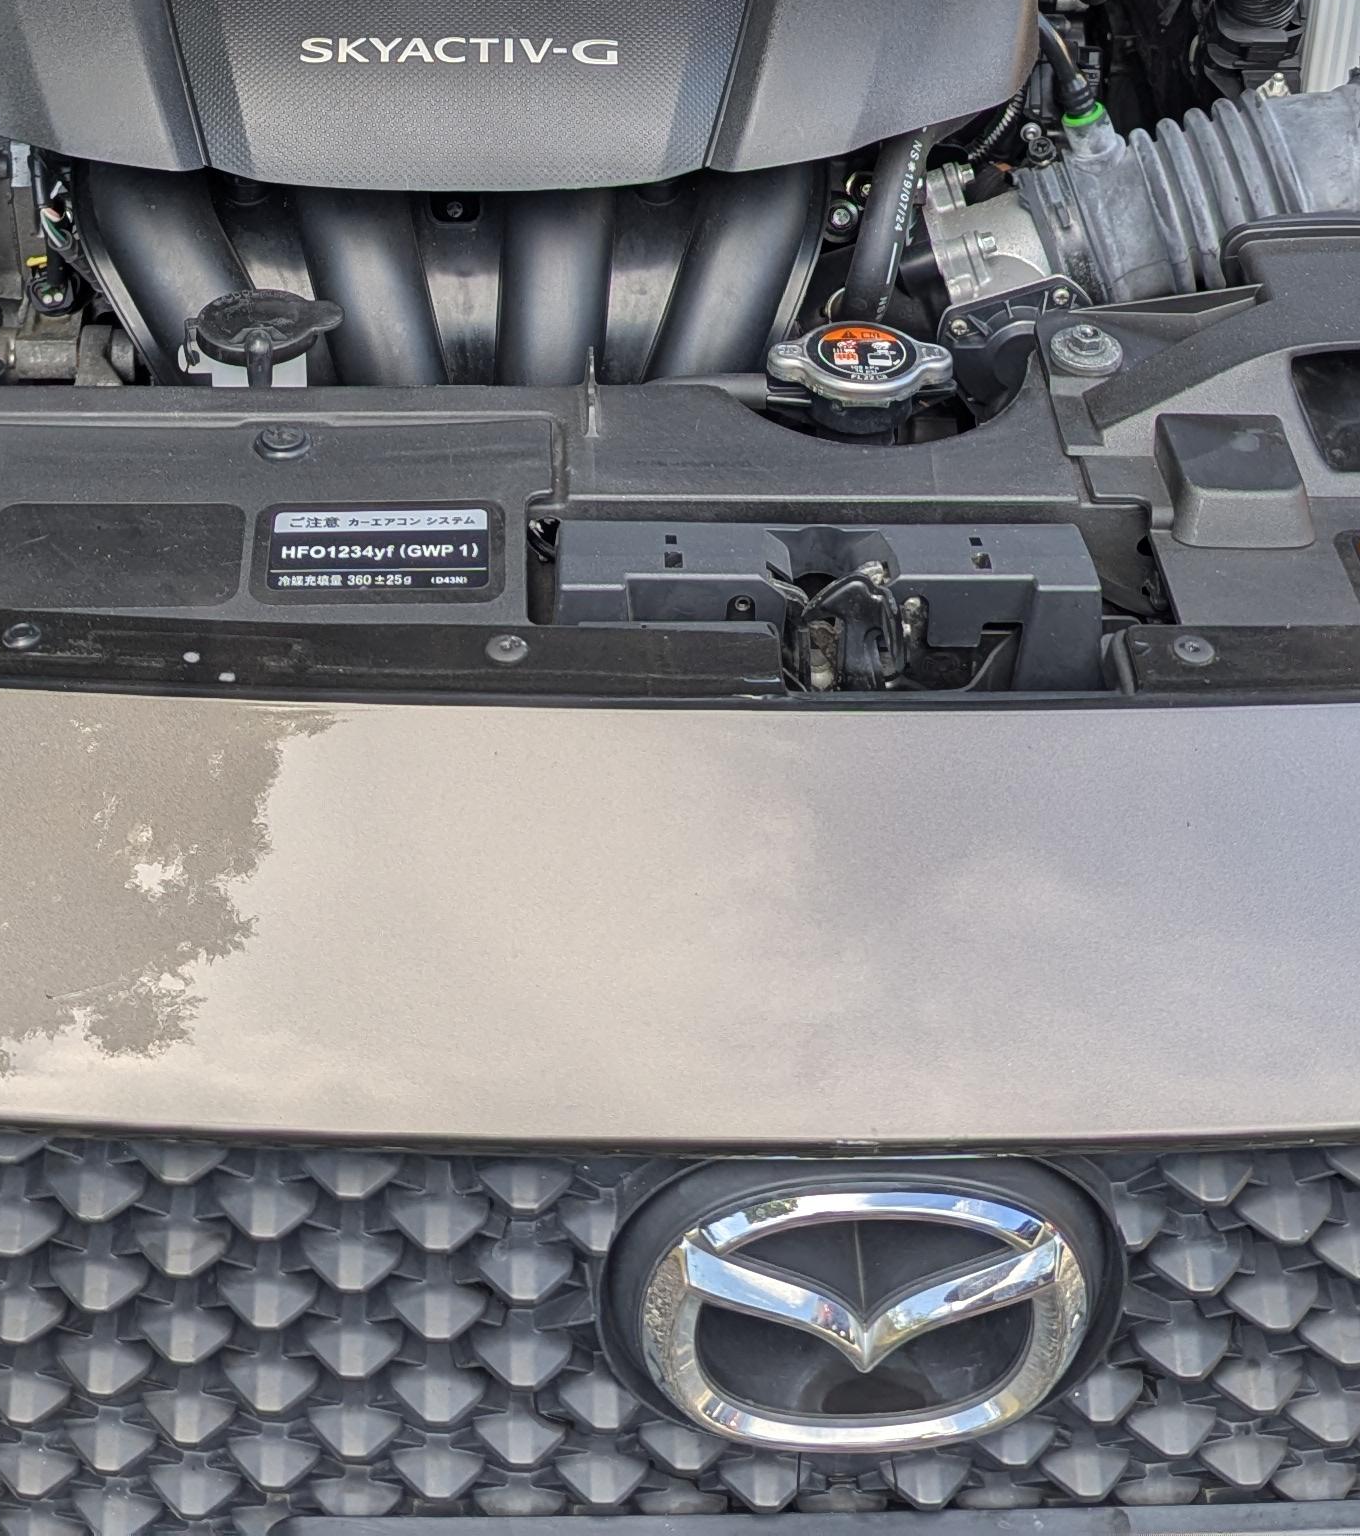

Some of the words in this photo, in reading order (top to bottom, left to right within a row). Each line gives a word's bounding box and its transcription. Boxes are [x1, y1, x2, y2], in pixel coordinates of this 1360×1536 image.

[299, 36, 619, 66] SKYACTIV-G
[289, 516, 341, 528] ご注意
[347, 517, 422, 527] カーエアコン
[426, 516, 476, 526] システム
[280, 544, 395, 560] HFO1234yf
[399, 543, 455, 559] (GWP
[458, 542, 479, 558] 1)
[346, 574, 372, 586] 360
[430, 575, 468, 585] (D43N)
